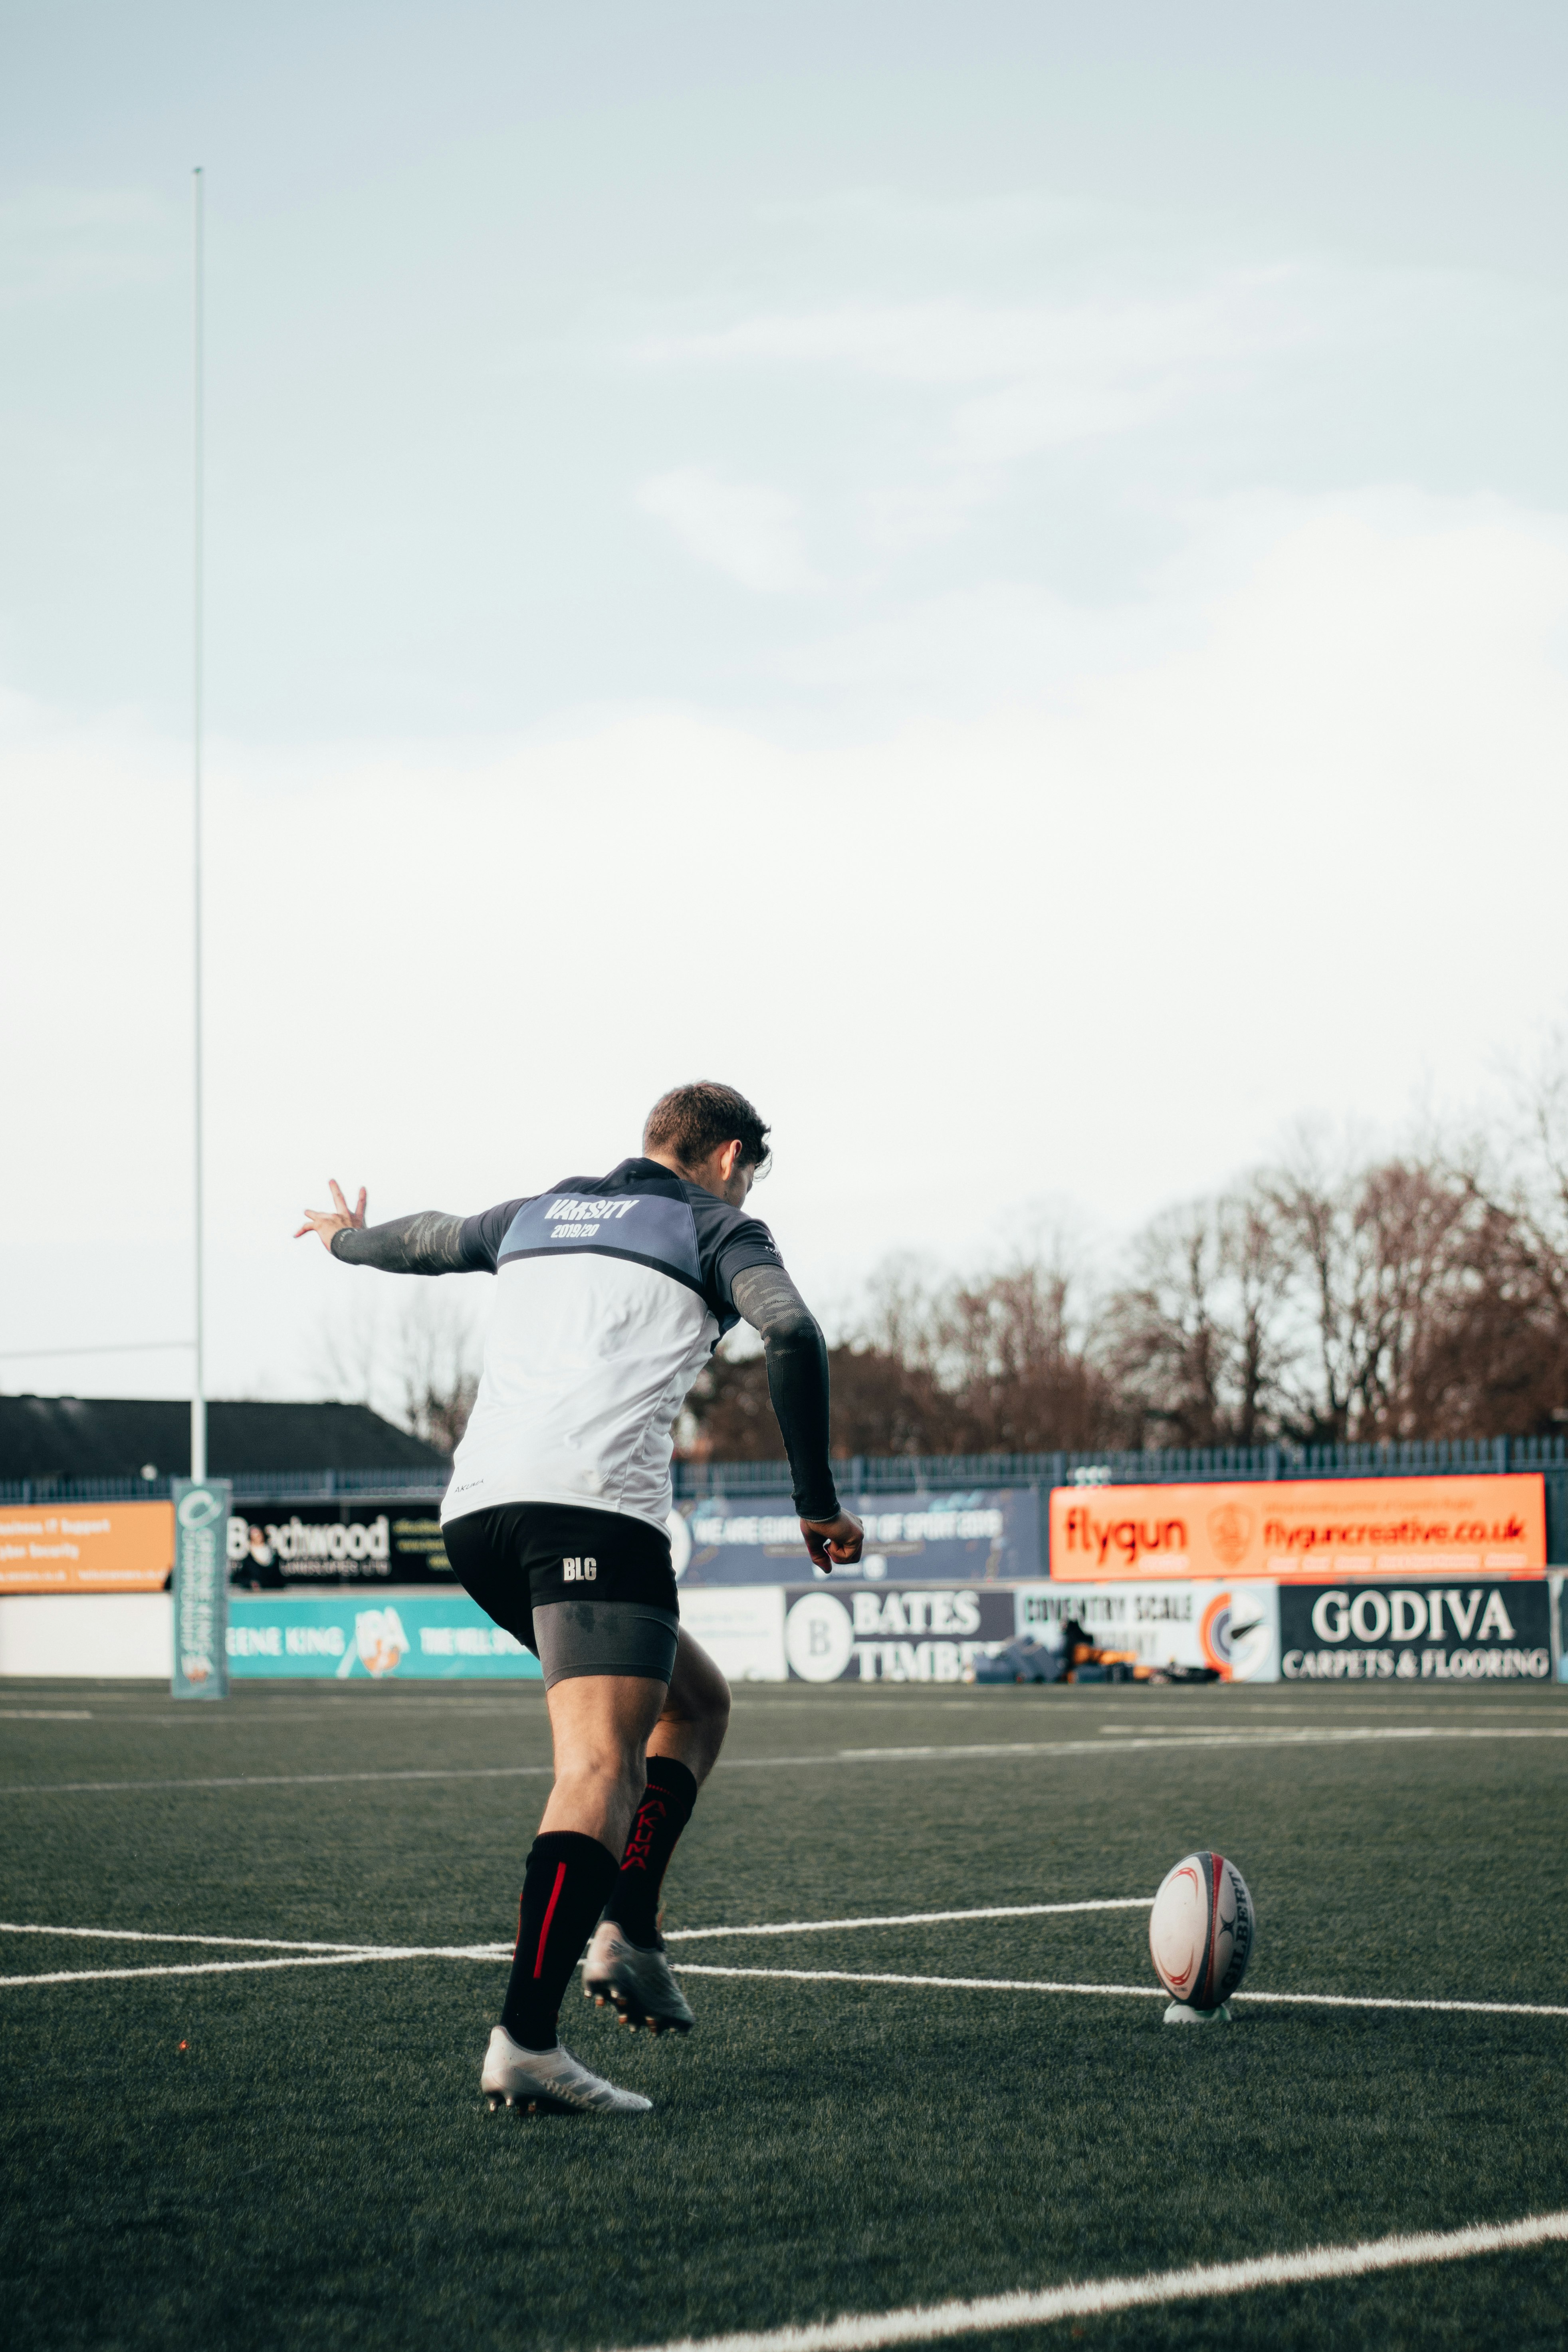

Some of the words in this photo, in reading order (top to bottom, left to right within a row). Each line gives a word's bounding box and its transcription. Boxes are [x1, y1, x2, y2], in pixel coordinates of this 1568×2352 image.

[544, 1199, 640, 1221] VARSITY
[550, 1223, 600, 1238] 2019/20
[454, 1478, 484, 1493] AKUMA
[226, 1514, 390, 1559] Bchwood
[1066, 1506, 1188, 1567] flygun
[1263, 1514, 1528, 1553] flyguncreative.co.uk
[563, 1557, 597, 1581] BLG
[852, 1590, 980, 1635] BATES
[1025, 1596, 1127, 1623] COVENTRY
[1136, 1595, 1193, 1622] SCALE
[1312, 1589, 1516, 1643] GODIVA
[225, 1626, 282, 1657] EENE
[285, 1626, 345, 1657] KING
[809, 1620, 831, 1656] B
[852, 1641, 1006, 1682] TIMBE
[1281, 1649, 1396, 1678] CARPETS
[1396, 1649, 1419, 1678] &
[1420, 1647, 1550, 1678] FLOORING
[620, 1800, 666, 1871] AKUMA
